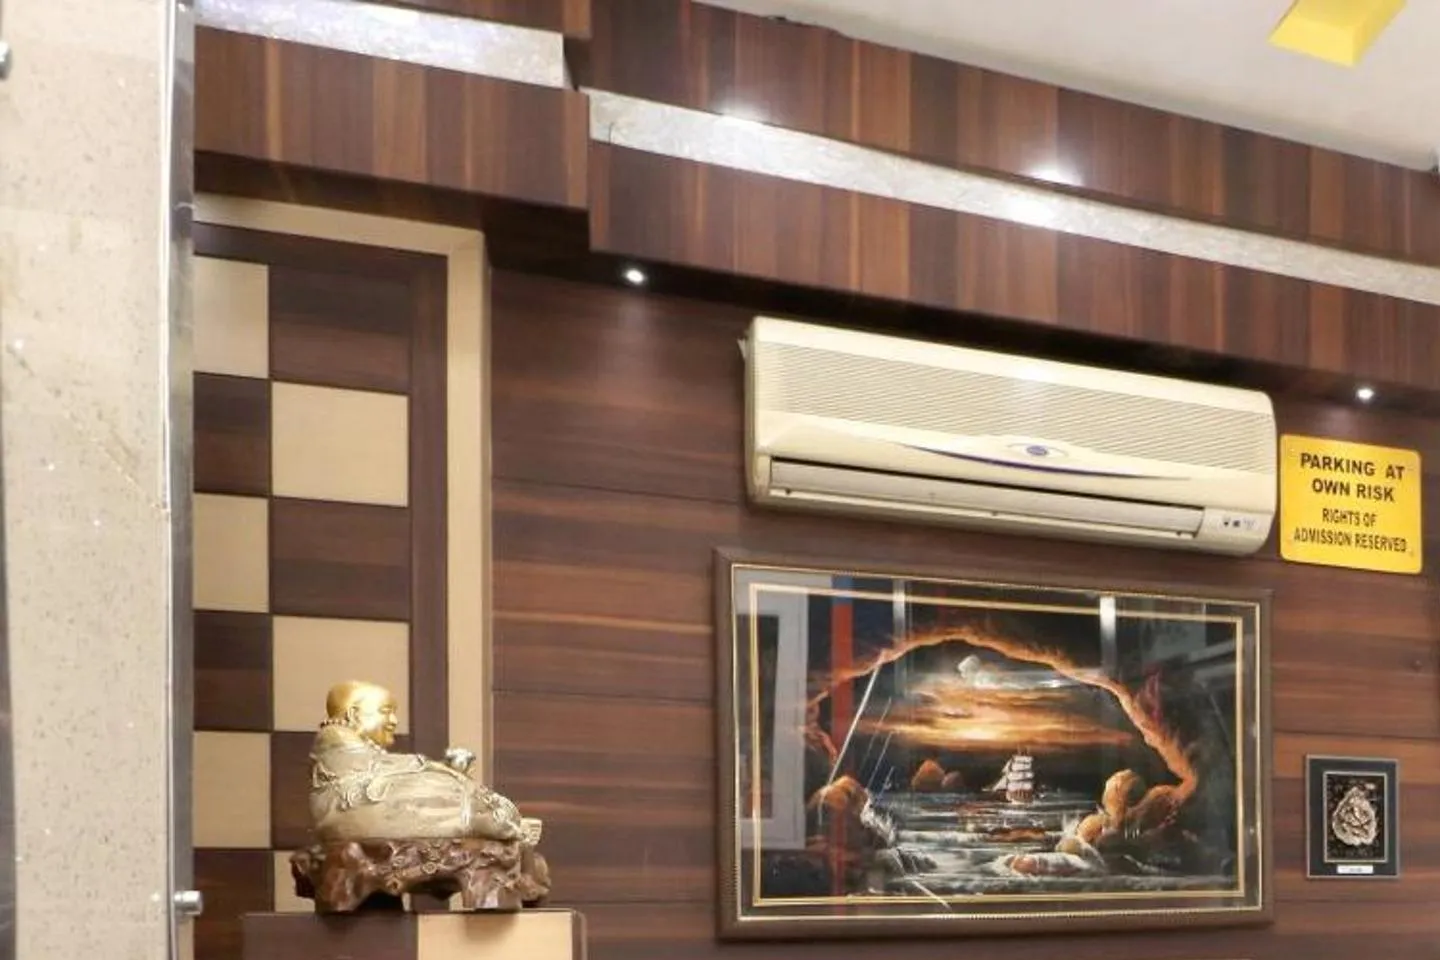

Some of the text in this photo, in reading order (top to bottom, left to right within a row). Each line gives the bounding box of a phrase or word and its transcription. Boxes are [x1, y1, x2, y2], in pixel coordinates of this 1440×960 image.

[1300, 452, 1405, 480] PARKING AT
[1311, 478, 1396, 502] OWN RISK
[1322, 508, 1378, 527] RIGHTS OF
[1293, 527, 1407, 553] ADMISSION RESERVED
